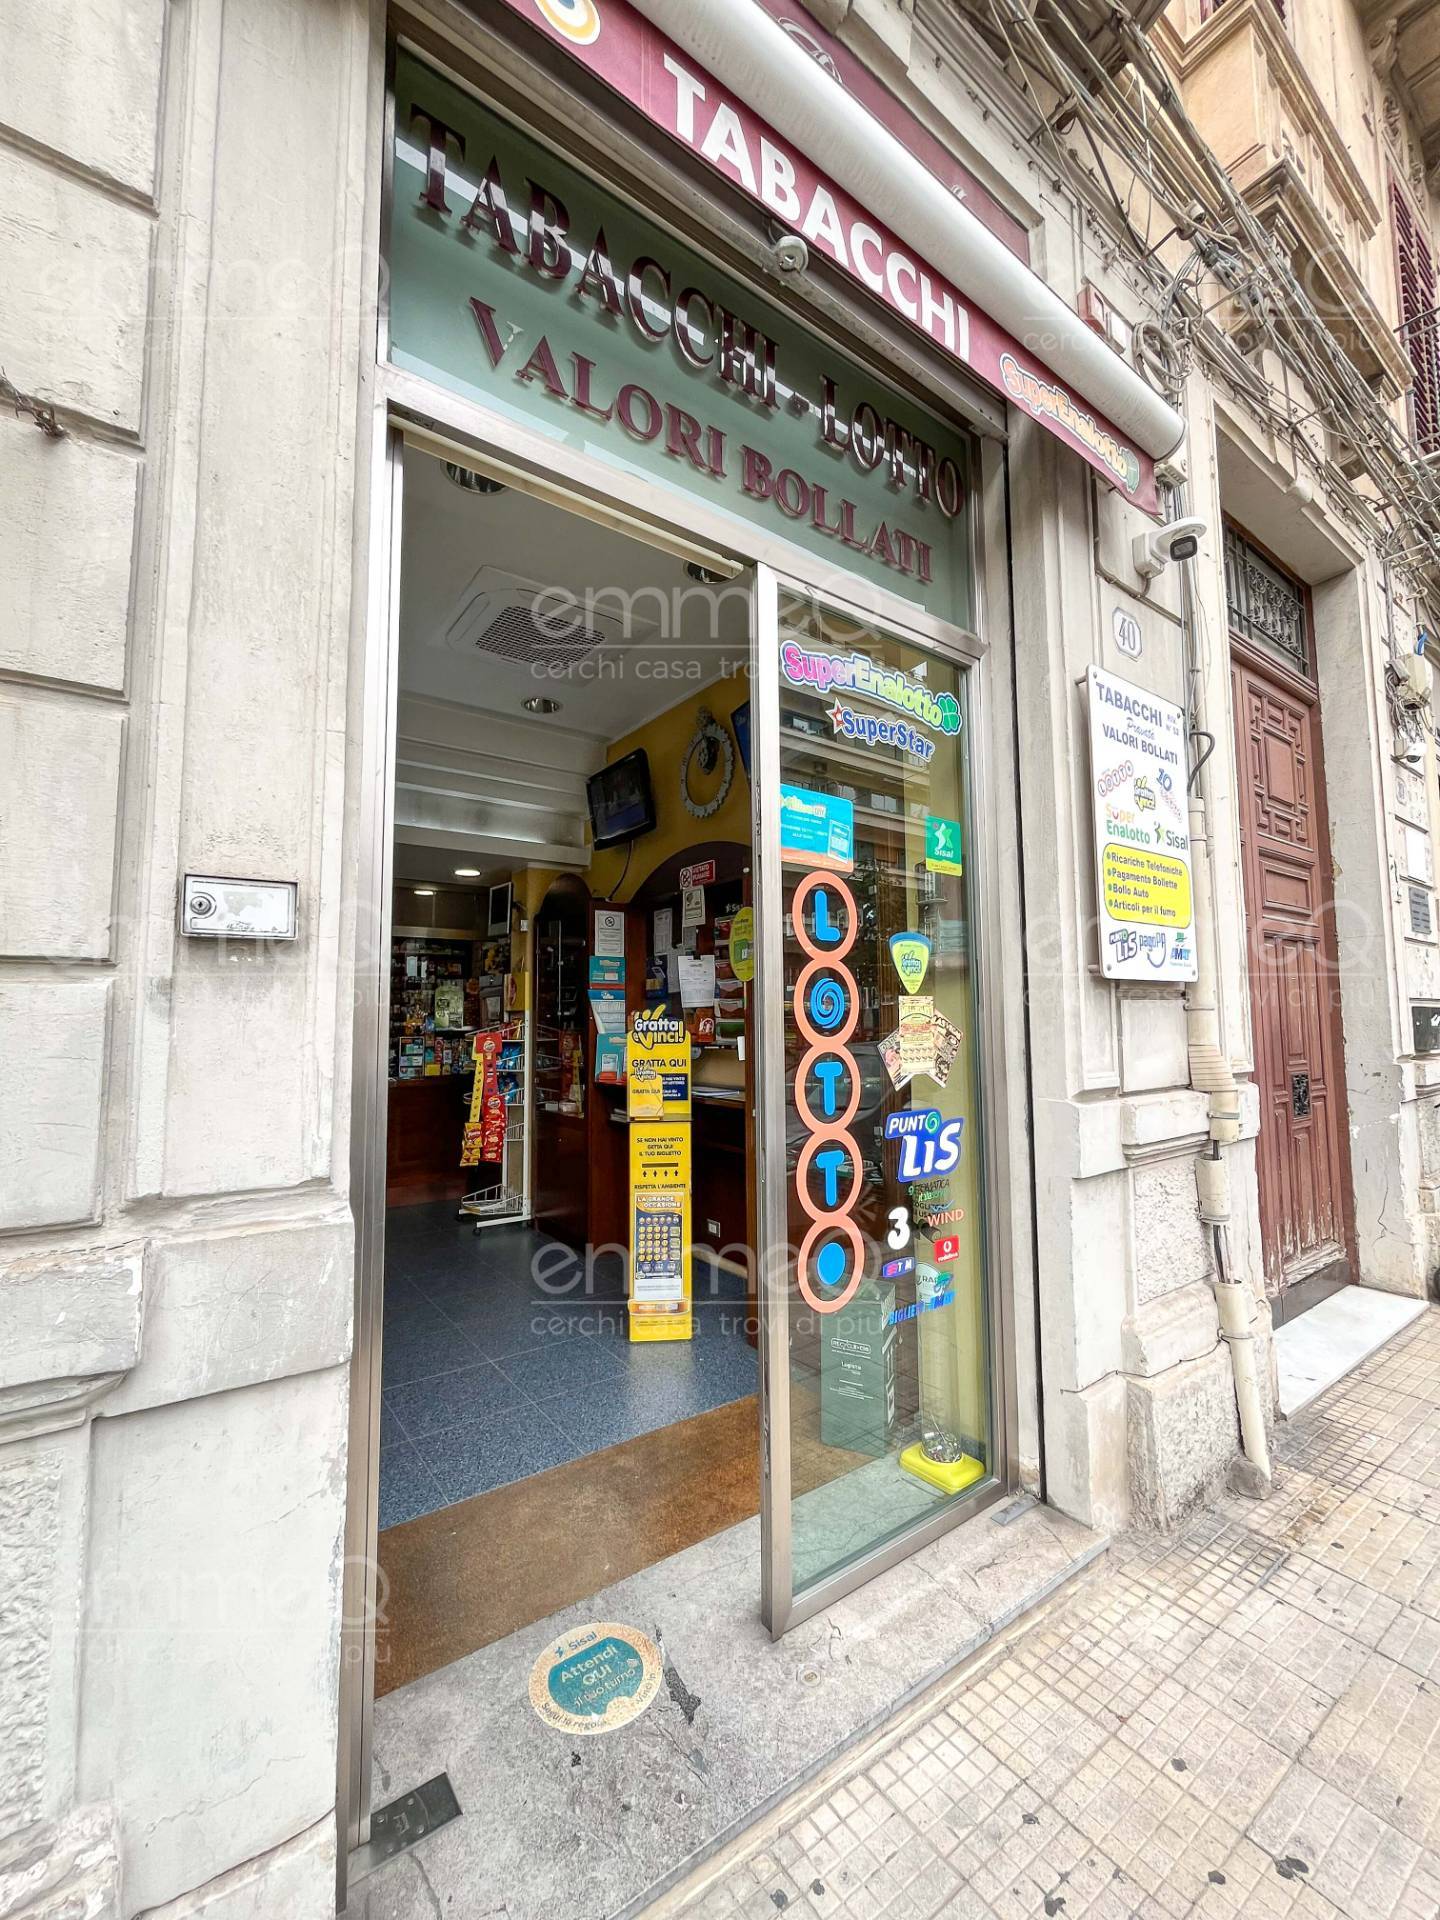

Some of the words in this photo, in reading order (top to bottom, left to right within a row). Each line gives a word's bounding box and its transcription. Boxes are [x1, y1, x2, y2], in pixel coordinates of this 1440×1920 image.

[664, 52, 970, 364] TABACCHI
[409, 102, 780, 411] TABACCHI
[820, 373, 964, 519] LOTTO
[1000, 353, 1130, 482] SuperEnalotto
[468, 296, 728, 479] VALORI
[741, 444, 934, 584] BOLLATI
[1119, 616, 1136, 651] 40
[783, 641, 943, 727] SuperEnalotto
[1096, 681, 1162, 728] TABACCHI
[841, 711, 936, 759] SuperStar
[1102, 722, 1139, 751] VALORI
[1141, 739, 1179, 766] BOLLATI
[1098, 760, 1134, 797] LOTTO
[1105, 803, 1136, 825] Super
[1106, 819, 1151, 845] Enalotto
[1165, 829, 1188, 851] Sisal
[934, 848, 954, 858] Sisal
[1111, 851, 1145, 869] Ricariche
[1146, 859, 1183, 877] Telefoniche
[1112, 867, 1151, 884] Pagamento
[1153, 875, 1178, 889] Bollette
[1112, 883, 1131, 895] Bollo
[1133, 887, 1149, 898] Auto
[1113, 899, 1140, 912] Articoli
[1142, 905, 1152, 915] per
[1160, 905, 1177, 917] fumo
[634, 1018, 679, 1032] Gratta
[632, 1059, 667, 1068] GRATTA
[669, 1059, 687, 1068] QUI
[889, 1111, 940, 1135] PUNTO
[887, 1206, 911, 1251] 3
[926, 1208, 965, 1228] WIND
[568, 1630, 598, 1651] Sisal
[560, 1643, 619, 1683] Attendi
[582, 1663, 613, 1686] QUI
[604, 1668, 636, 1691] turno
